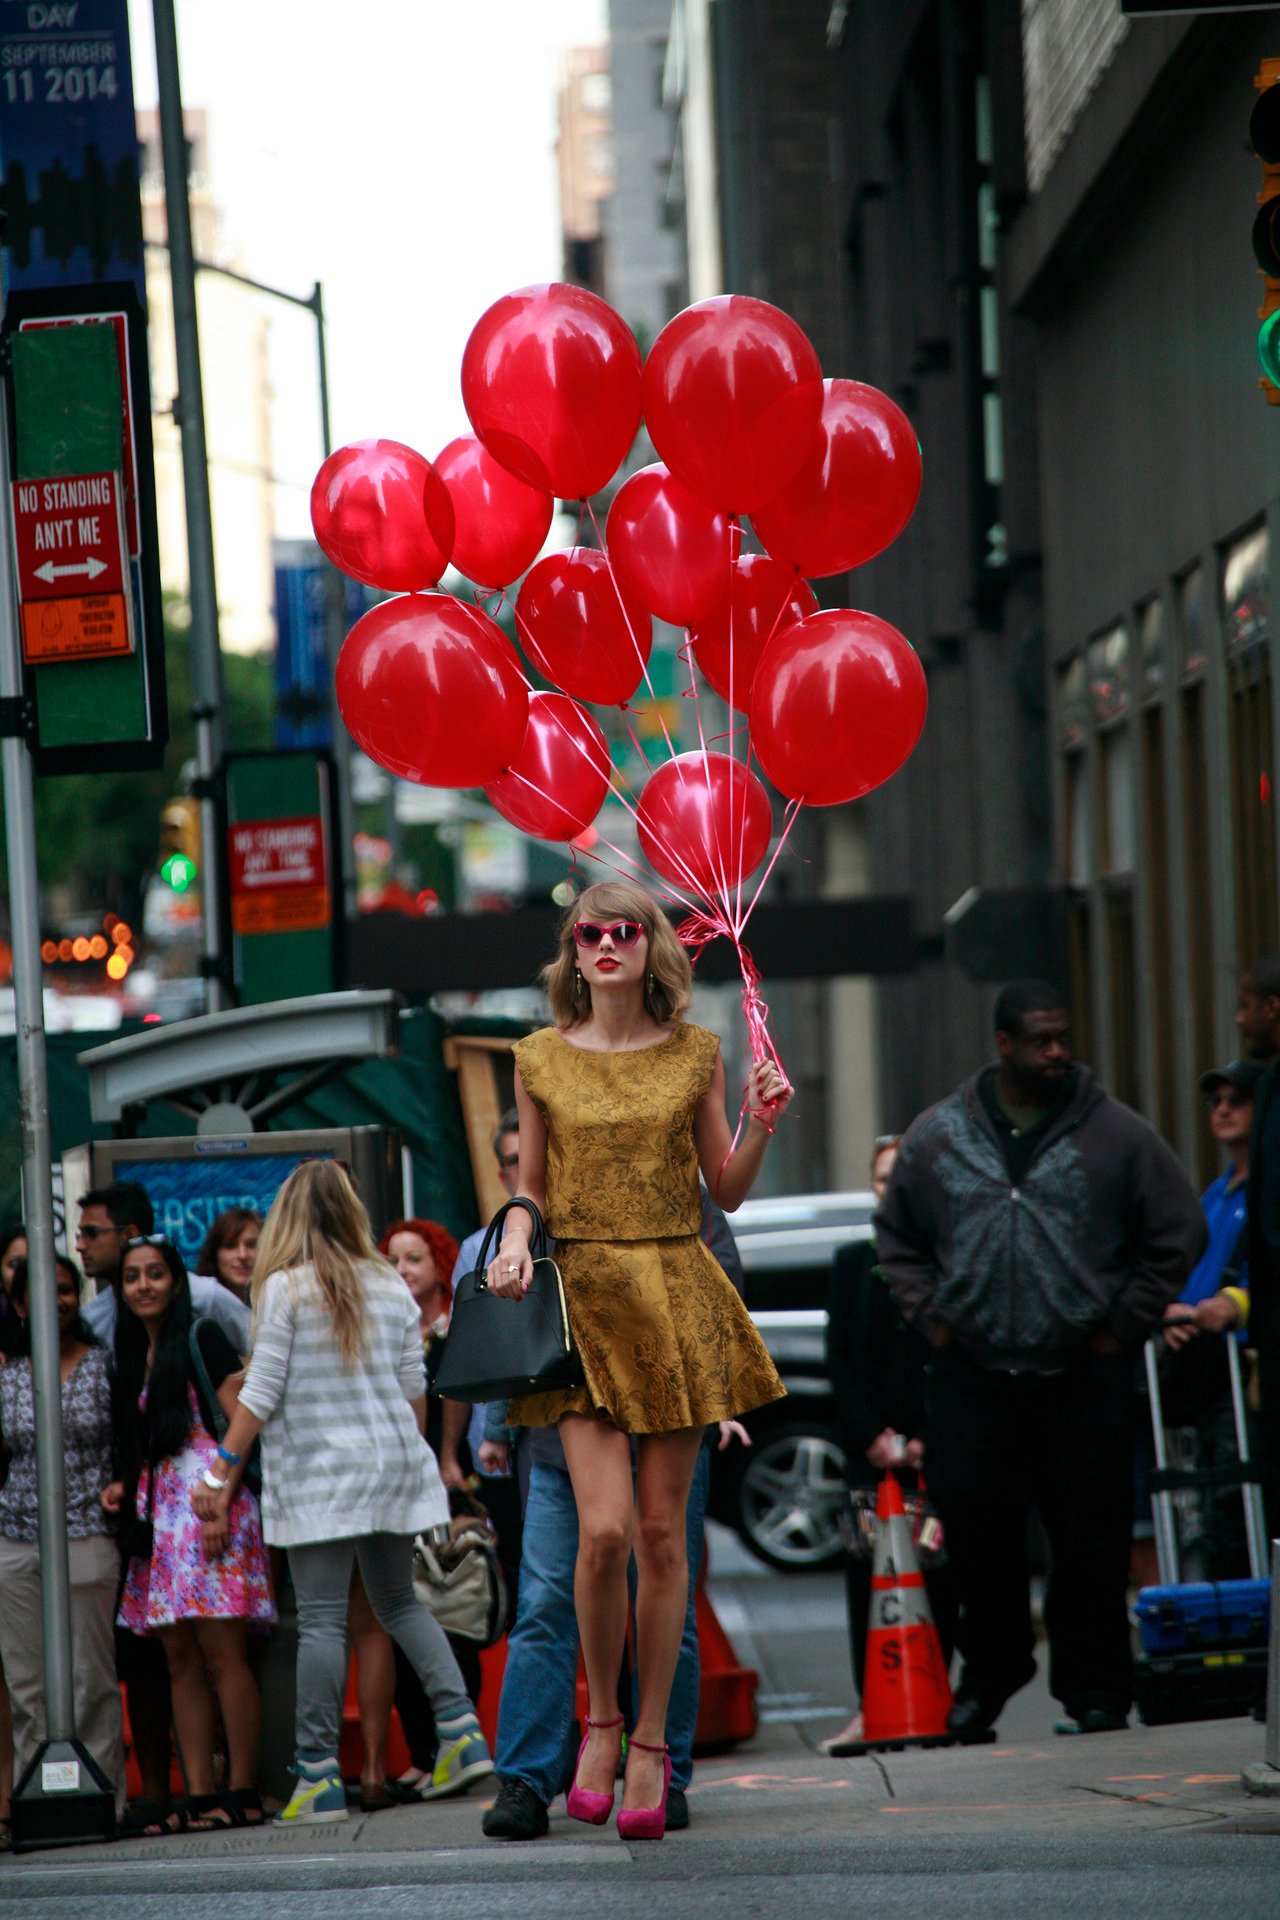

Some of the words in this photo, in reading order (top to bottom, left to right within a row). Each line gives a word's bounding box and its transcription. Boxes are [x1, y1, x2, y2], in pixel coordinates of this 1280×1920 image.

[26, 2, 79, 29] DAY
[1, 41, 117, 67] SEPTEMBER
[2, 68, 34, 103] 11
[44, 65, 118, 102] 2014
[19, 485, 38, 513] NO
[43, 477, 111, 512] STANDING
